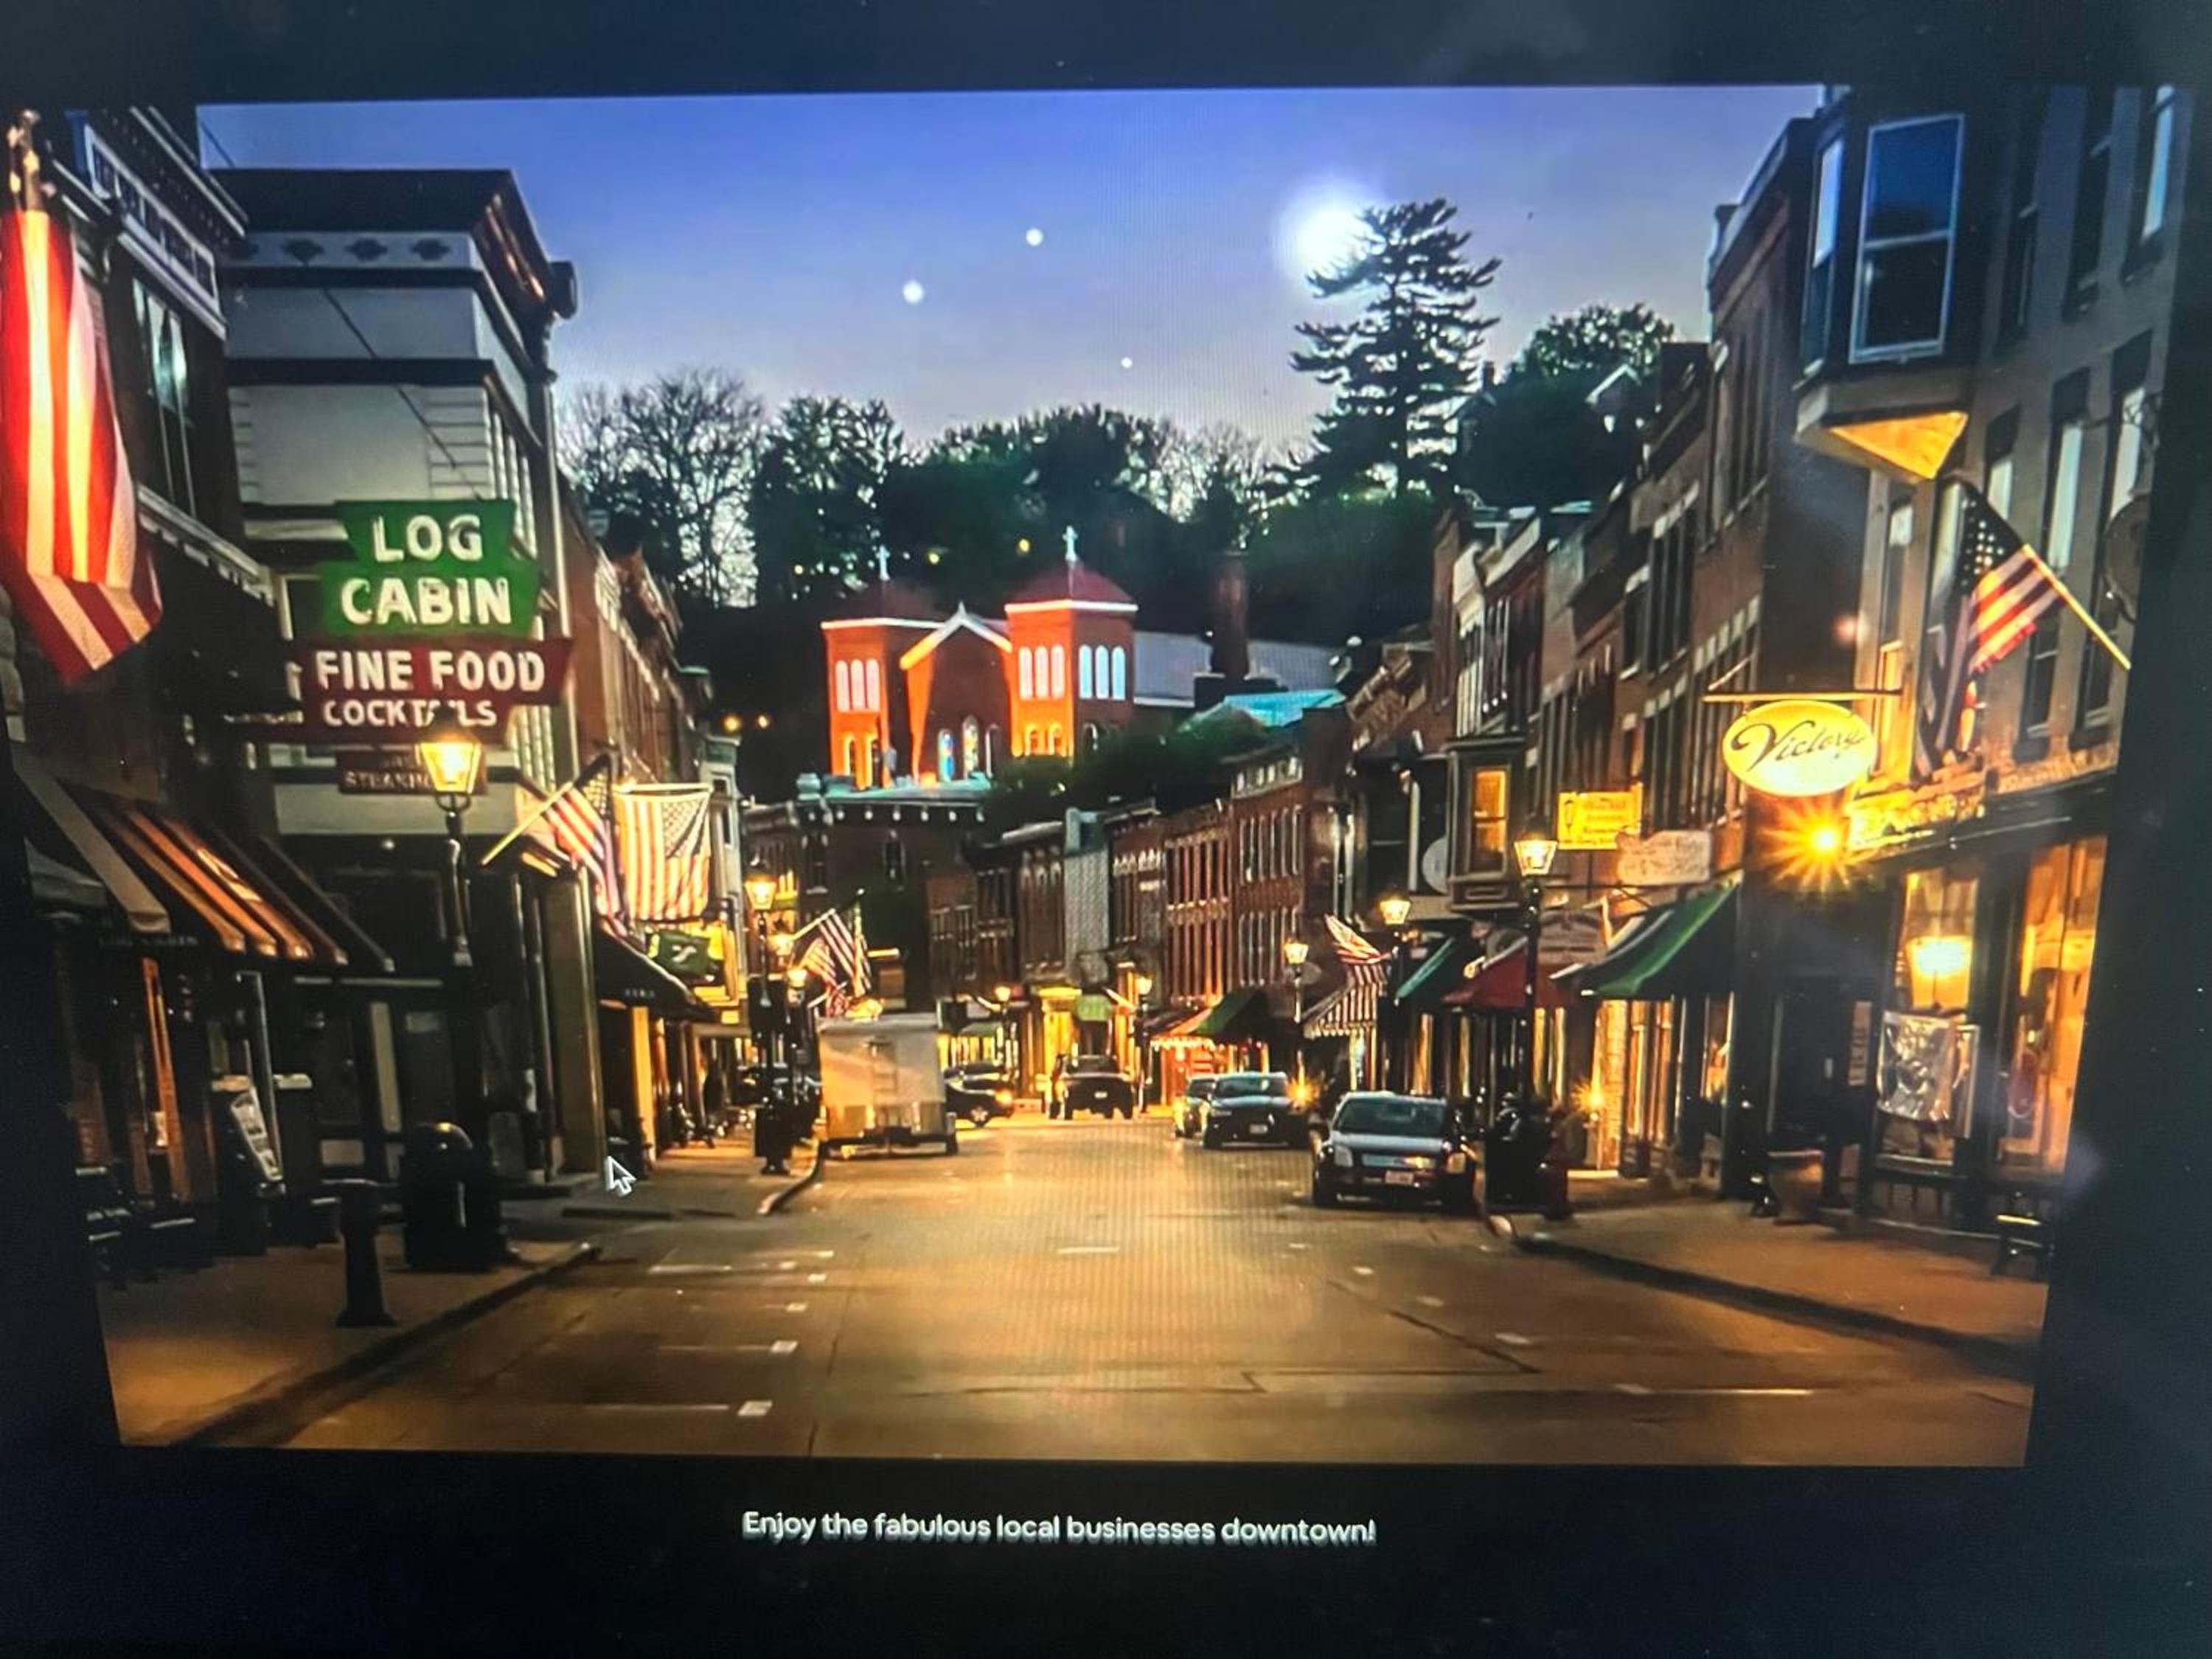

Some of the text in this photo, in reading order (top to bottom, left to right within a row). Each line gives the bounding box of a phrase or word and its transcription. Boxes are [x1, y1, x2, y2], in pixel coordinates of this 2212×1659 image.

[372, 514, 484, 563] LOG
[340, 577, 512, 625] CABIN
[315, 650, 546, 692] FINE FOOD
[323, 699, 498, 727] COCKTALS
[742, 1511, 1377, 1545] Enjoy the fabulous local businesses downtown!
